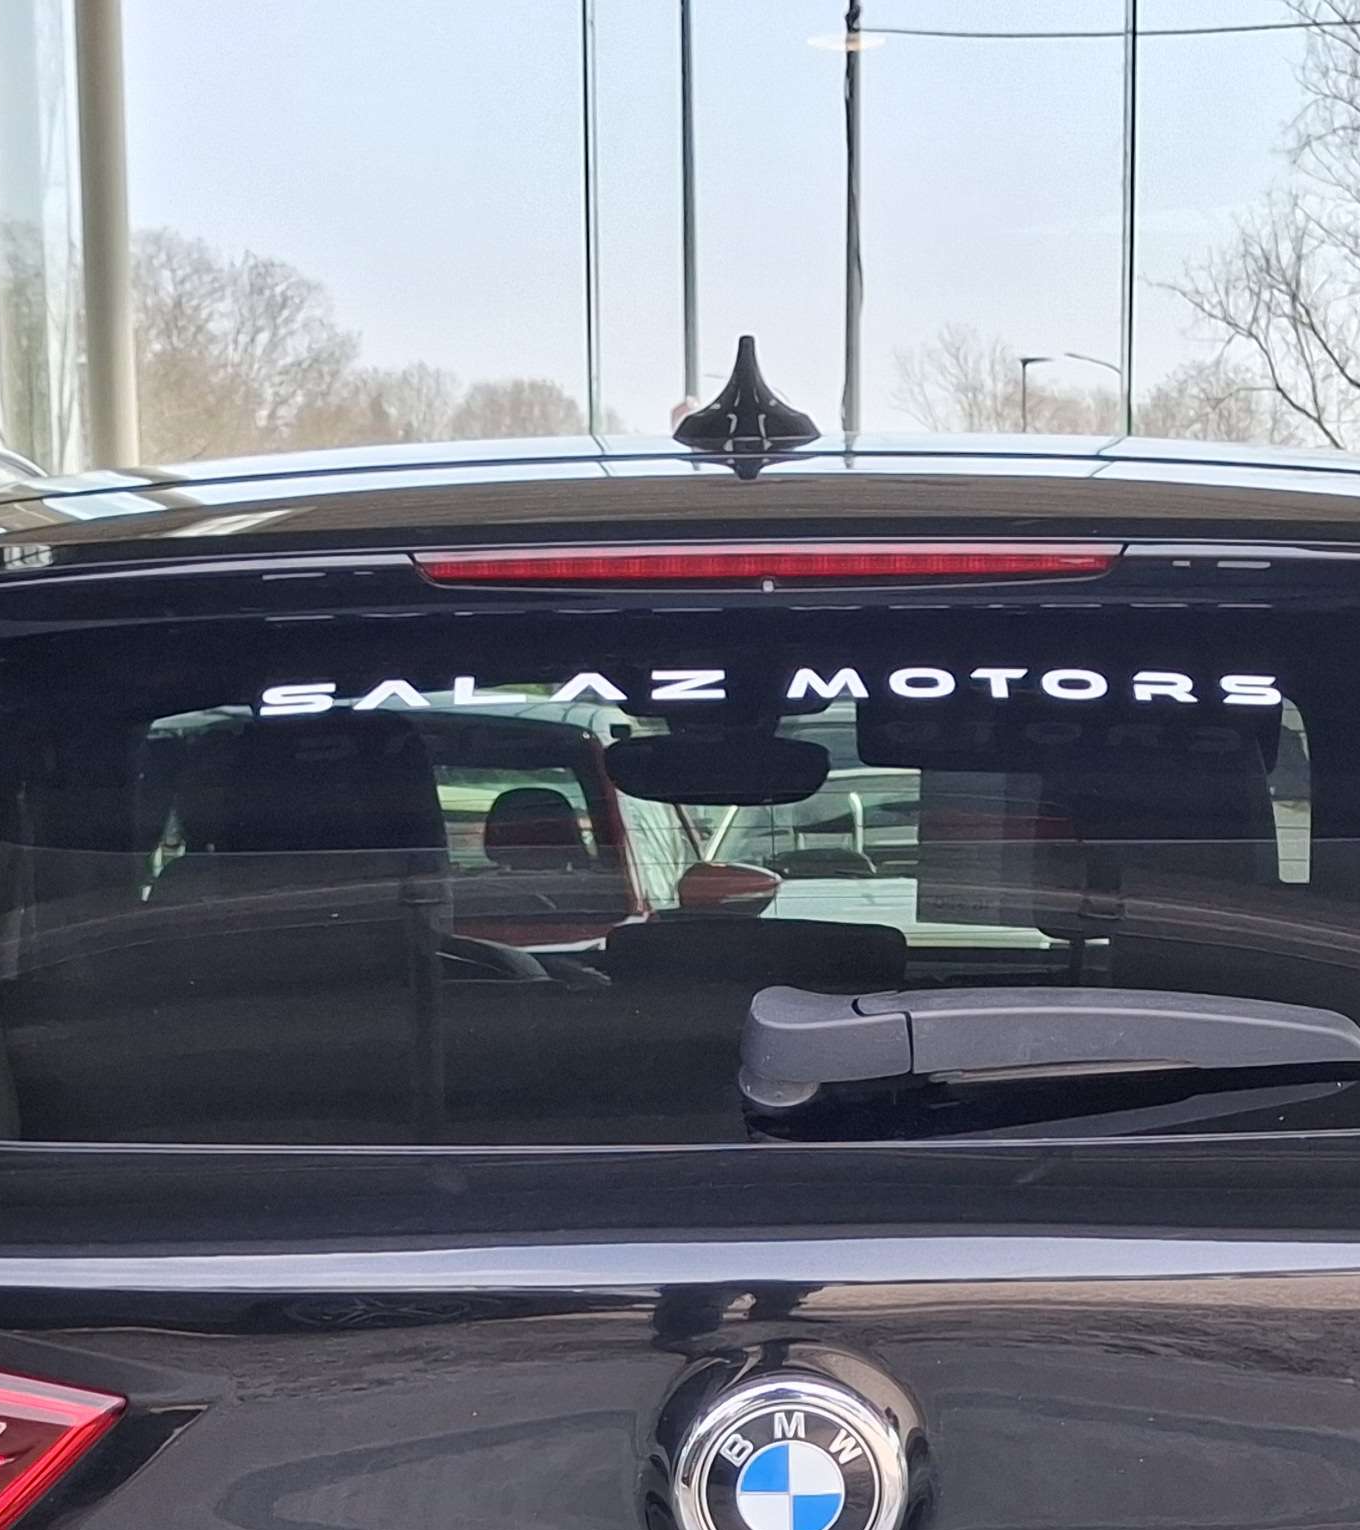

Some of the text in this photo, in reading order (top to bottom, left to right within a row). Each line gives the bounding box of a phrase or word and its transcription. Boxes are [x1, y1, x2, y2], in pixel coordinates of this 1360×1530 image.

[259, 667, 1283, 718] SALAZ MOTORS
[719, 1410, 864, 1468] BMW
